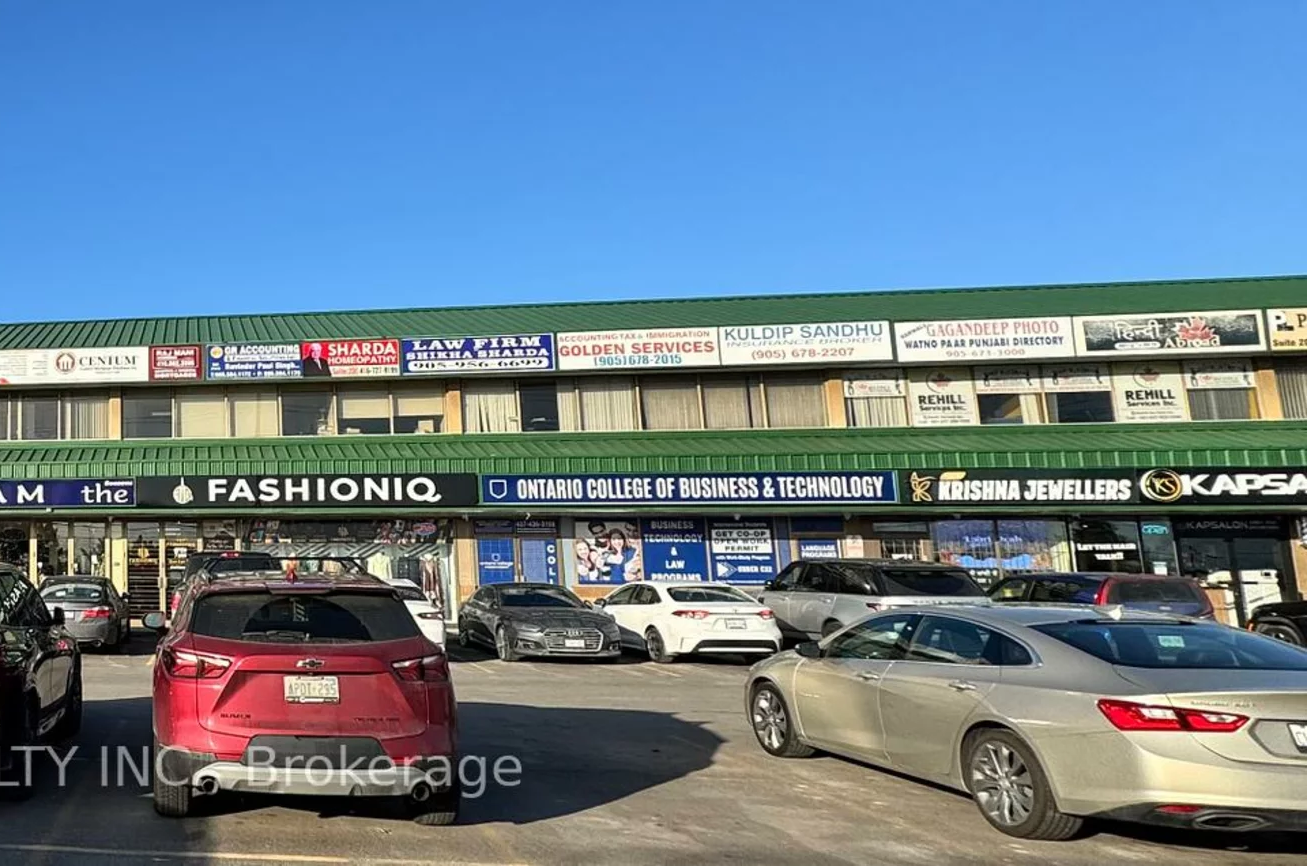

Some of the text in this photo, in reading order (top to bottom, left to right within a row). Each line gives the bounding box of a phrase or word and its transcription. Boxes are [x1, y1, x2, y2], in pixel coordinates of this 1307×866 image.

[646, 330, 710, 339] IMMIGRATION
[724, 323, 883, 341] KULDIP SANDHU
[926, 320, 1059, 337] GAGANDEEP PHOTO
[412, 336, 542, 351] LAW FIRM
[726, 337, 882, 348] INSURANCE BROKER
[904, 335, 1064, 349] WATNO PAAR PUNJABI DIRECTORY
[1164, 334, 1220, 348] Abroad
[240, 344, 300, 354] ACCOUNTING
[328, 342, 396, 356] SHARDA
[406, 348, 550, 360] SHIKHA SHARDA
[559, 341, 715, 357] GOLDEN SERVICES
[751, 347, 855, 360] (905) 678-2207
[327, 355, 396, 365] HOMEOPATHY
[918, 394, 966, 405] REHILL
[80, 482, 128, 503] the
[208, 477, 442, 502] FASHIONIQ
[517, 475, 884, 500] ONTARIO COLLEGE OF BUSINESS & TECHNOLOGY
[938, 479, 1132, 501] KRISHNA JEWELLERS
[651, 521, 694, 529] BUSINESS
[1186, 520, 1248, 529] KAPSALON
[644, 533, 703, 543] TECHNOLOGY
[665, 560, 685, 569] LAW
